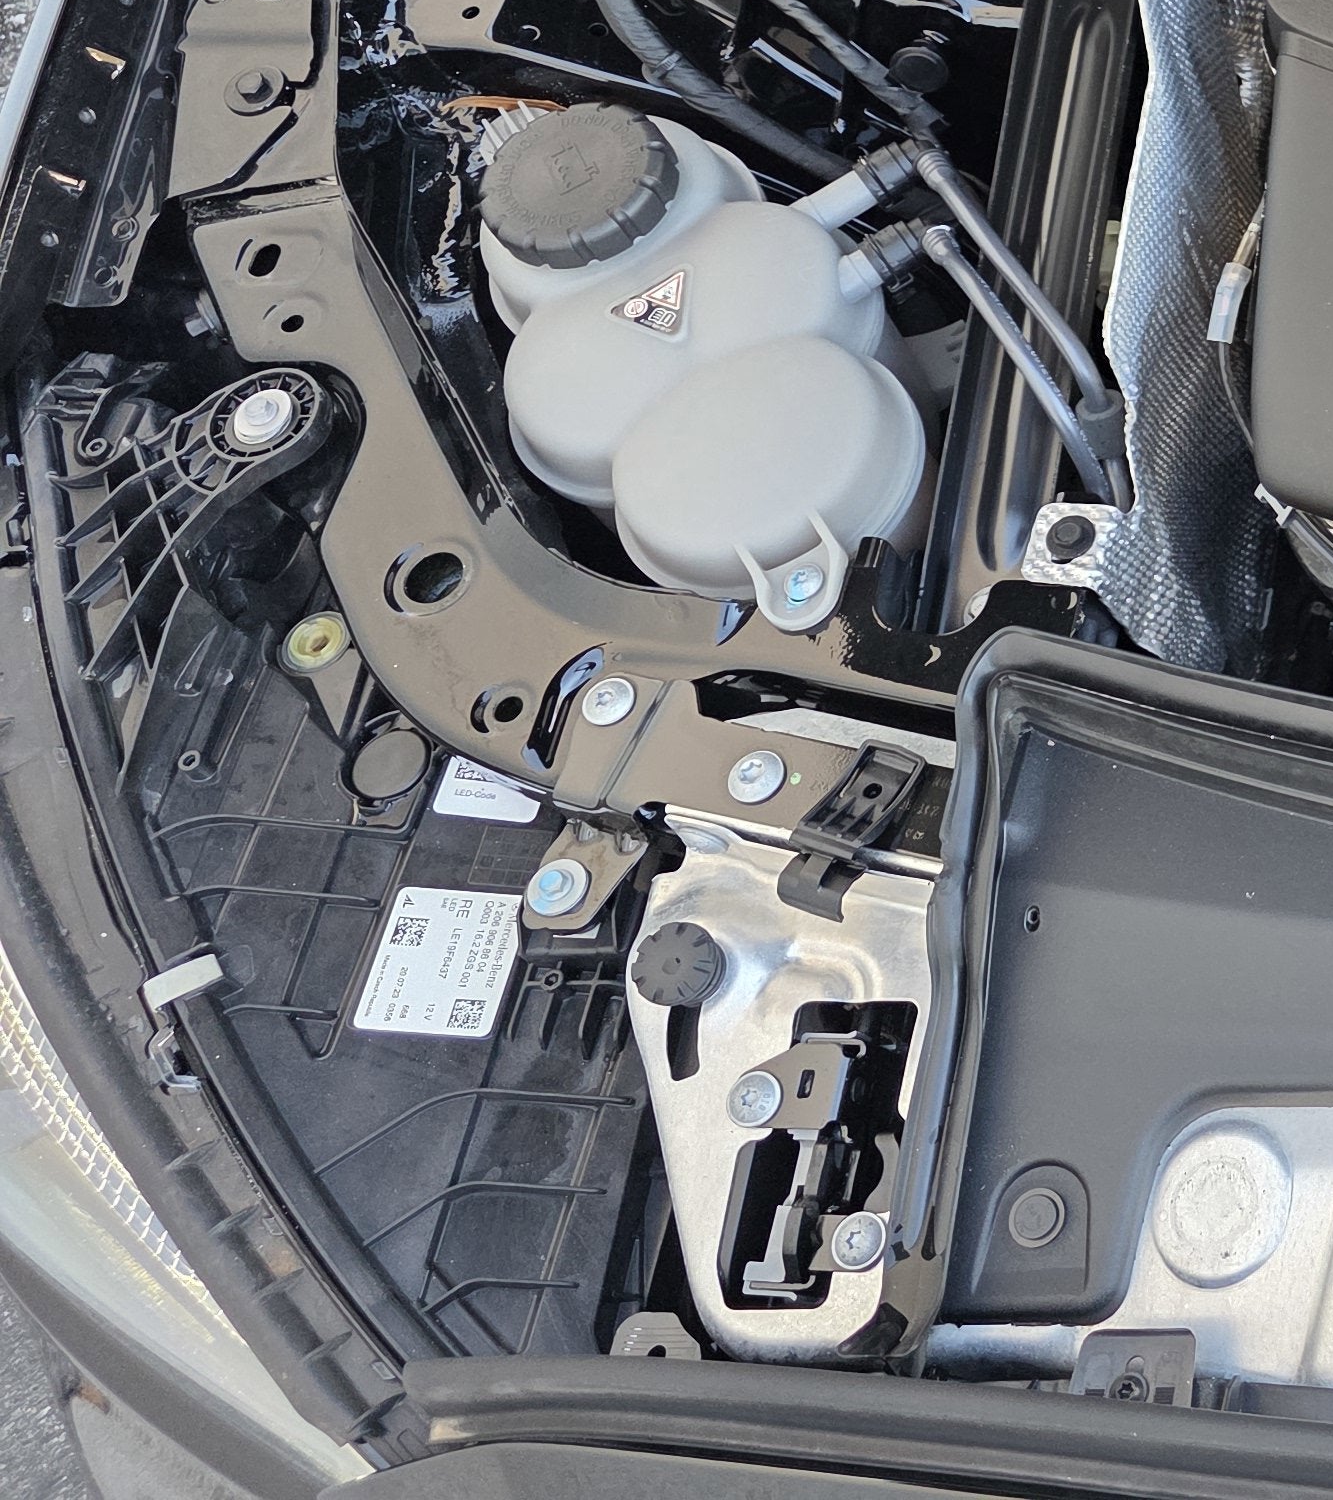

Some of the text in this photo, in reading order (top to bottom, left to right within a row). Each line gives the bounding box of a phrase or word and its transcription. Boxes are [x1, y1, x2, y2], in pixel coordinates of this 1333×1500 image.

[455, 788, 497, 799] LED-Code
[448, 898, 458, 912] LED
[456, 900, 473, 919] RE
[491, 910, 503, 927] 206
[458, 900, 494, 988] Q003 16.2 ZGS 001
[485, 929, 497, 946] 906
[438, 927, 463, 980] LE19F6437
[485, 913, 517, 989] Mercedes-Benz
[476, 963, 486, 973] 04
[425, 1003, 436, 1013] 12
